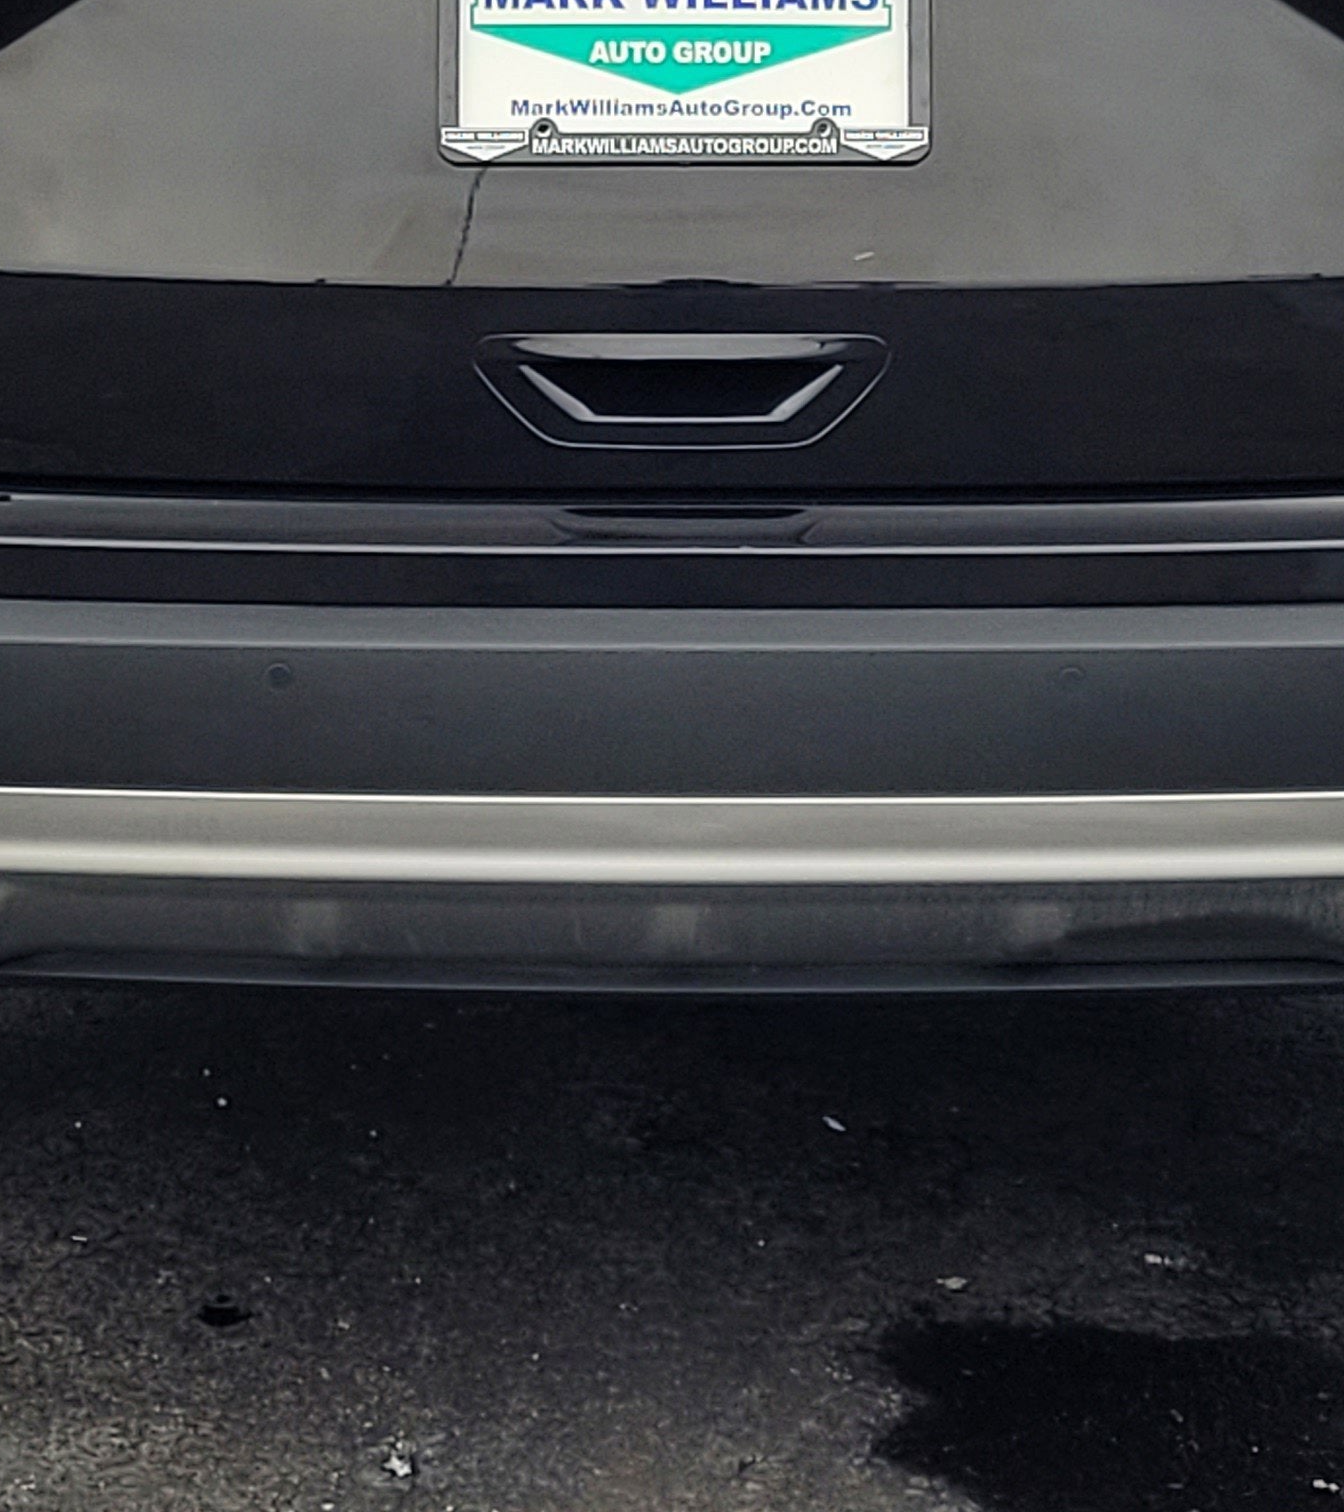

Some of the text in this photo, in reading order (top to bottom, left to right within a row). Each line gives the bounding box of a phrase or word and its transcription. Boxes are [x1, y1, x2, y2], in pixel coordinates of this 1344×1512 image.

[589, 40, 772, 65] AUTO GROUP
[510, 99, 852, 119] MarkWilliamsAutoGroup.Com
[531, 137, 838, 155] MARKWILLIAMSAUTOGROUP.COM
